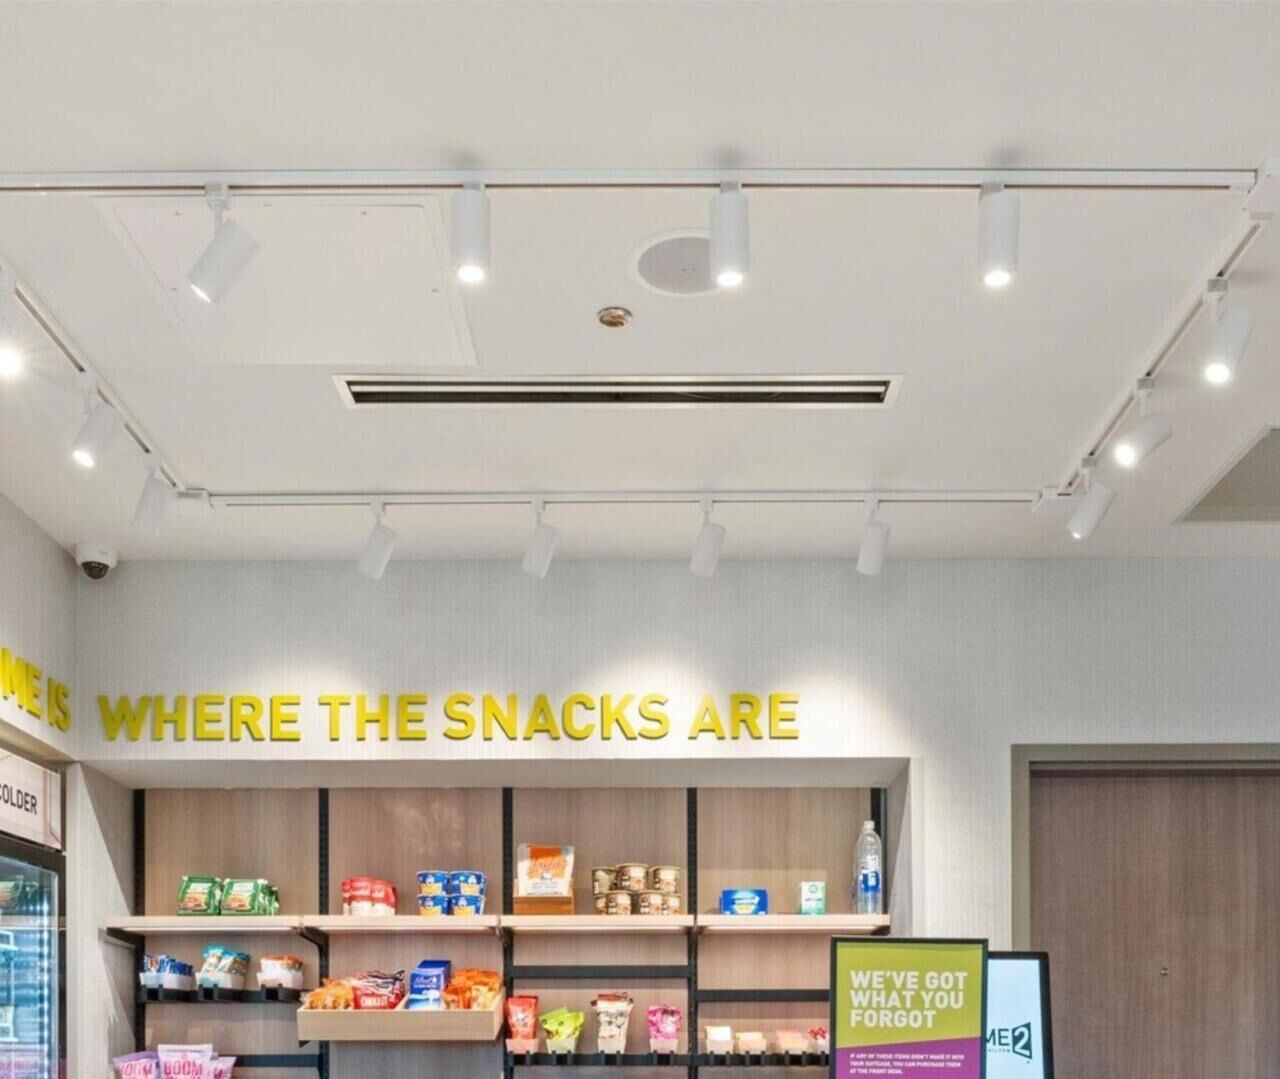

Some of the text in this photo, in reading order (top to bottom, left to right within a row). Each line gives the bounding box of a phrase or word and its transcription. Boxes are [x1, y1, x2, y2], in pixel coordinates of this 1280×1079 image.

[47, 677, 71, 733] IS
[97, 694, 302, 742] WHERE
[319, 693, 428, 742] THE
[443, 692, 671, 741] SNACKS
[687, 692, 800, 741] ARE
[849, 970, 968, 990] WE'VE GOT
[849, 990, 964, 1009] WHAT YOU
[849, 1009, 937, 1028] FORGOT
